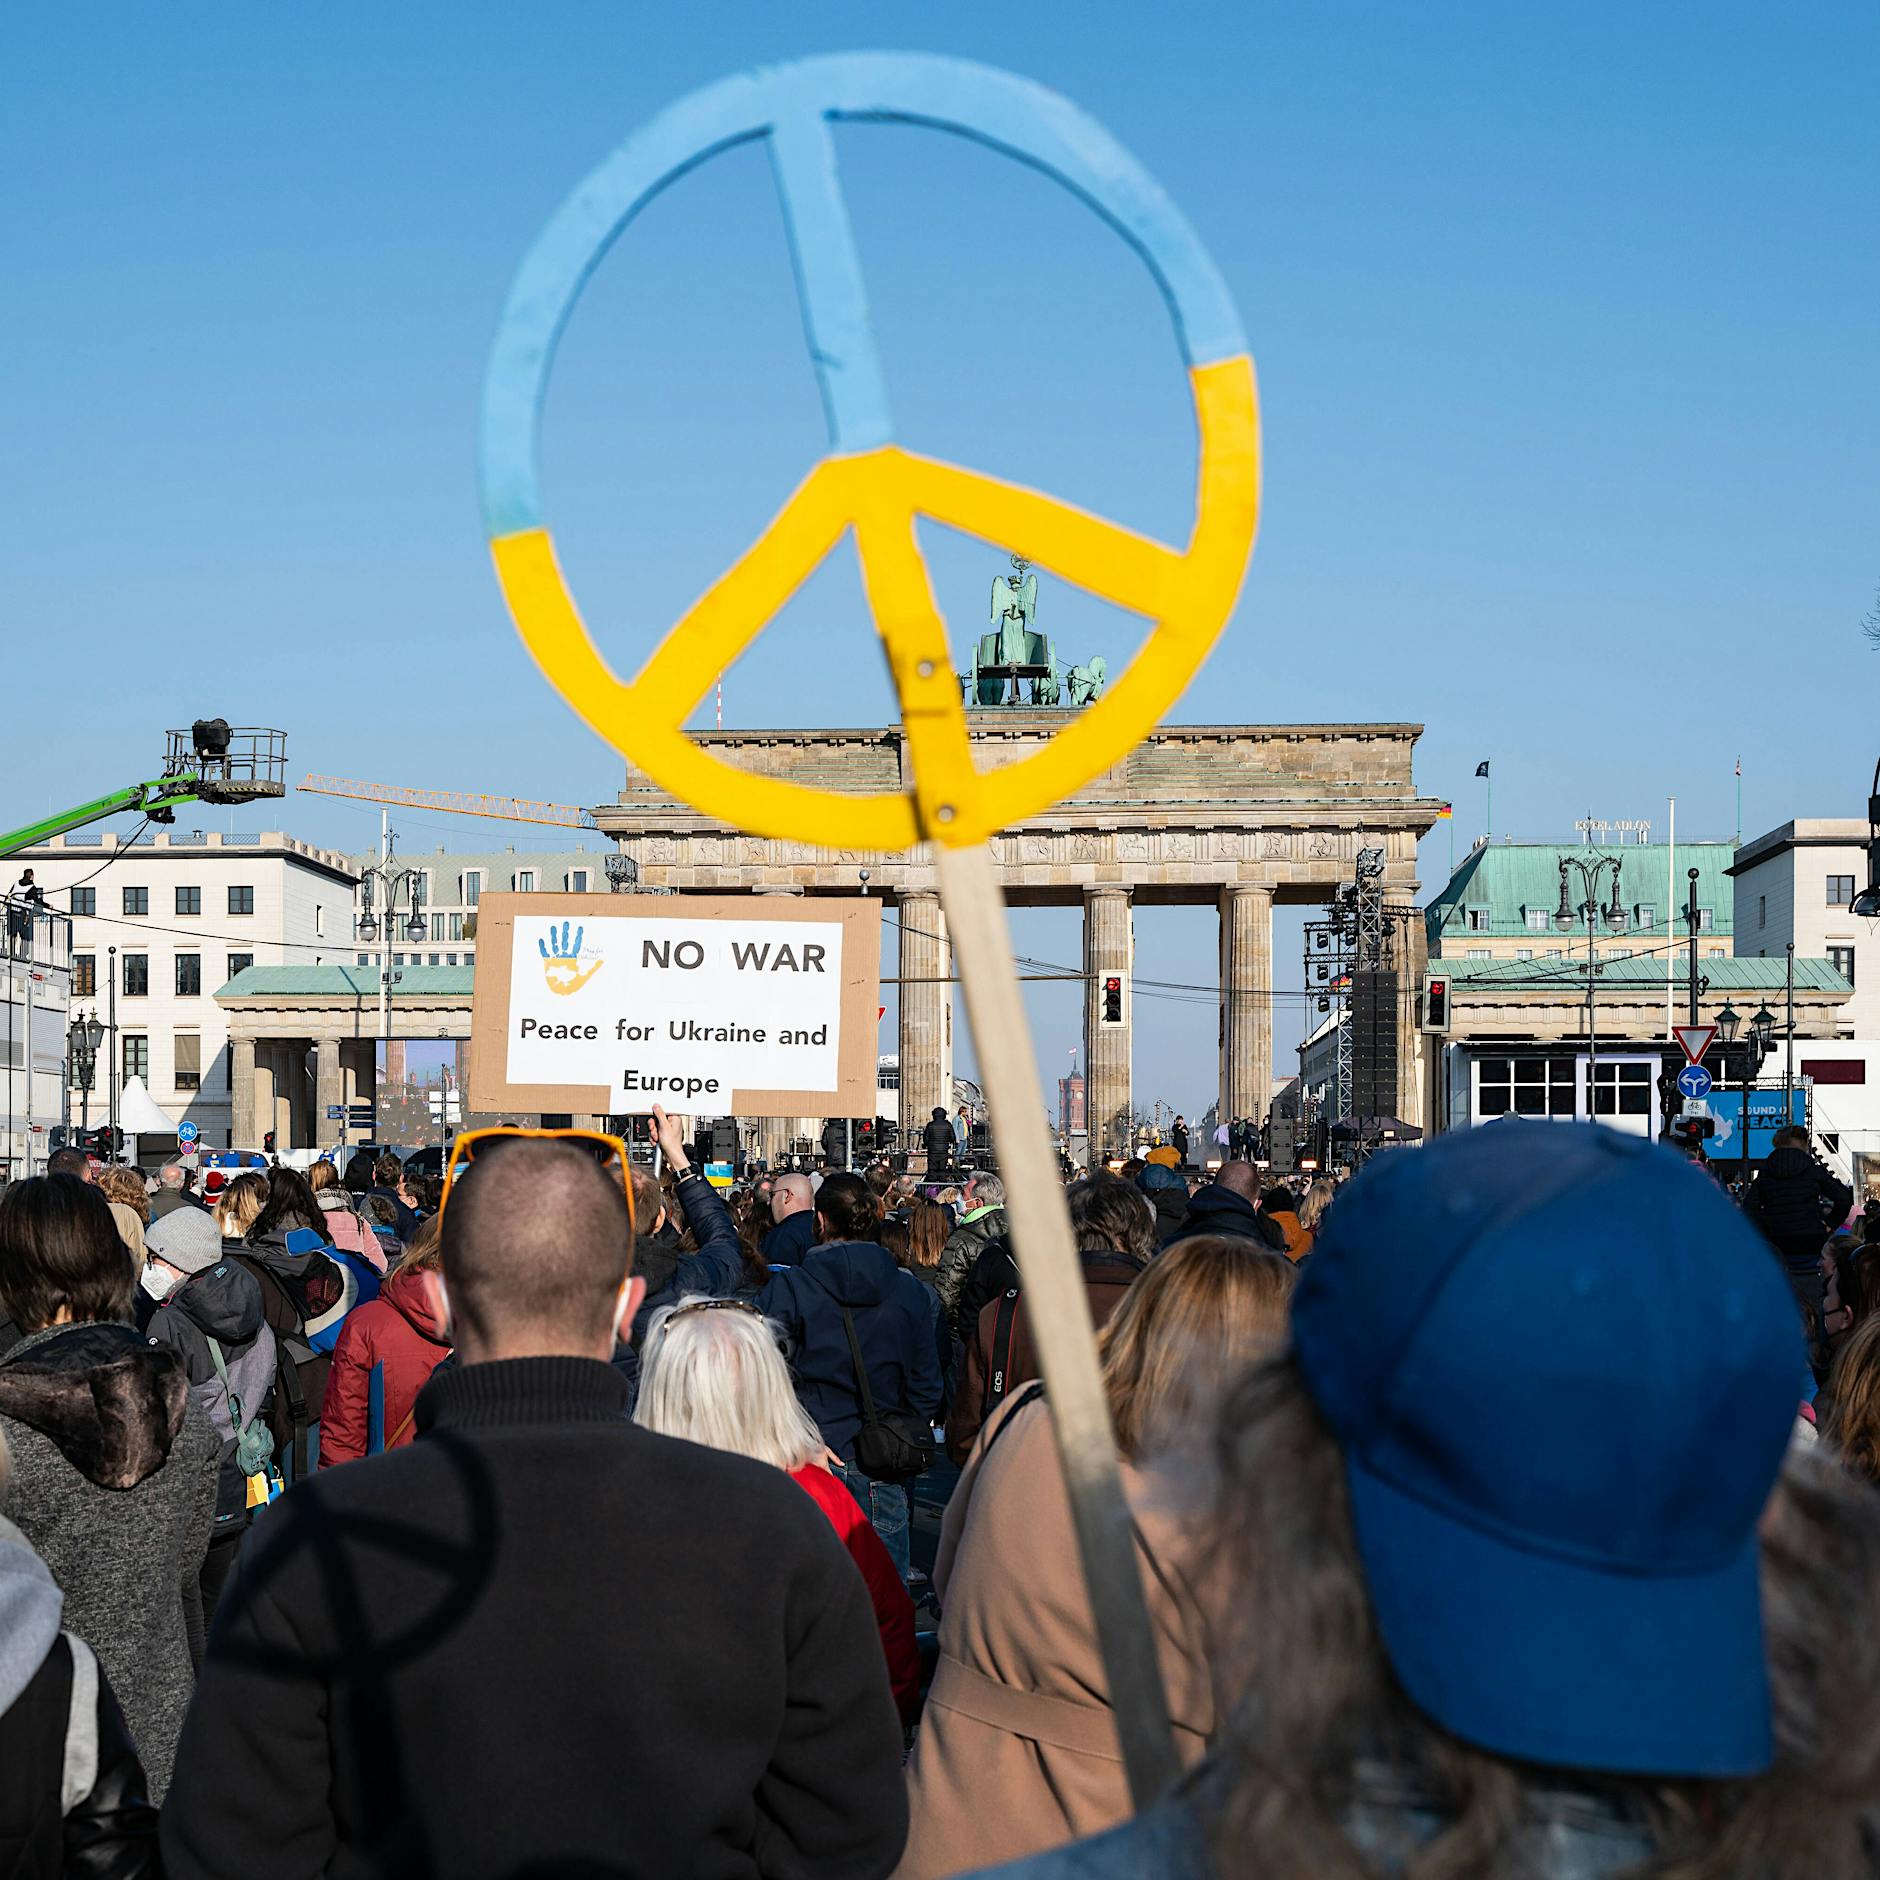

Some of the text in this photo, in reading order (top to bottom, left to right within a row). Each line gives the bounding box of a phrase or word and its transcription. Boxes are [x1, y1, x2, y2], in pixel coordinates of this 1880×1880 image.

[1613, 820, 1651, 831] ADLON
[641, 939, 705, 970] NO
[731, 942, 826, 973] WAR
[520, 1018, 827, 1046] Peace for Ukraine and
[623, 1069, 719, 1099] Europe
[994, 1371, 1003, 1392] EOS
